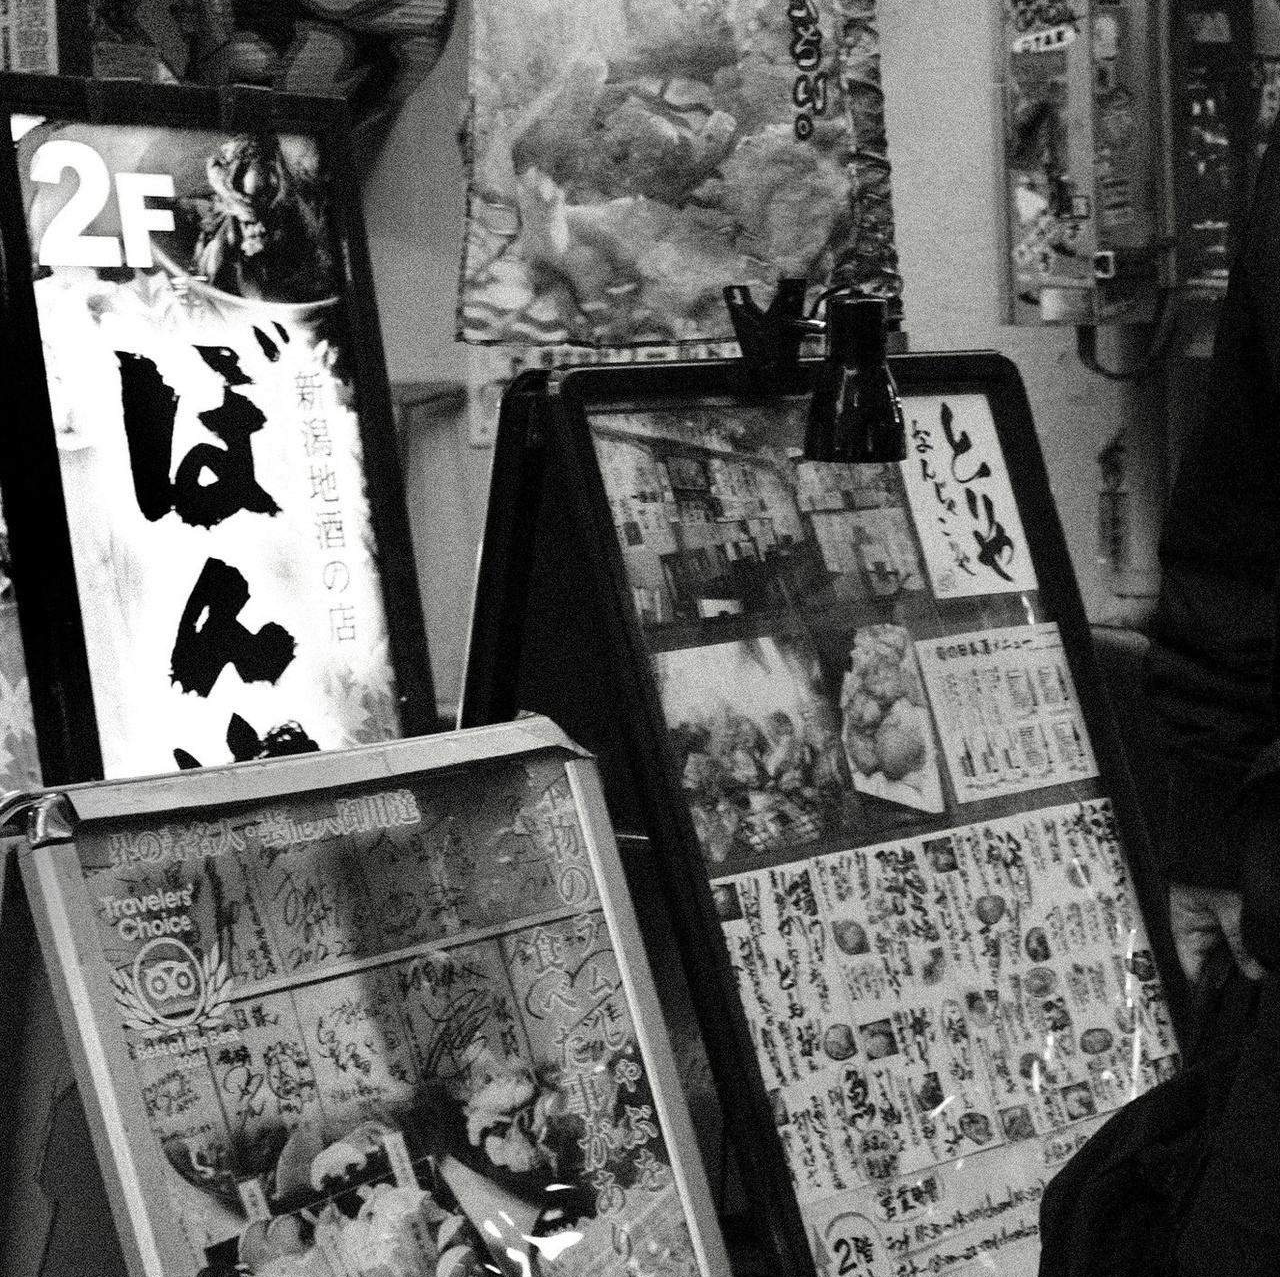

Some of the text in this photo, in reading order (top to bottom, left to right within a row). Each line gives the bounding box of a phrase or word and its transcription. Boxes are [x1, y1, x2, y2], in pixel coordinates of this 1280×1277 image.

[30, 140, 175, 268] 2F
[113, 322, 321, 771] ばん
[118, 911, 192, 943] Choice
